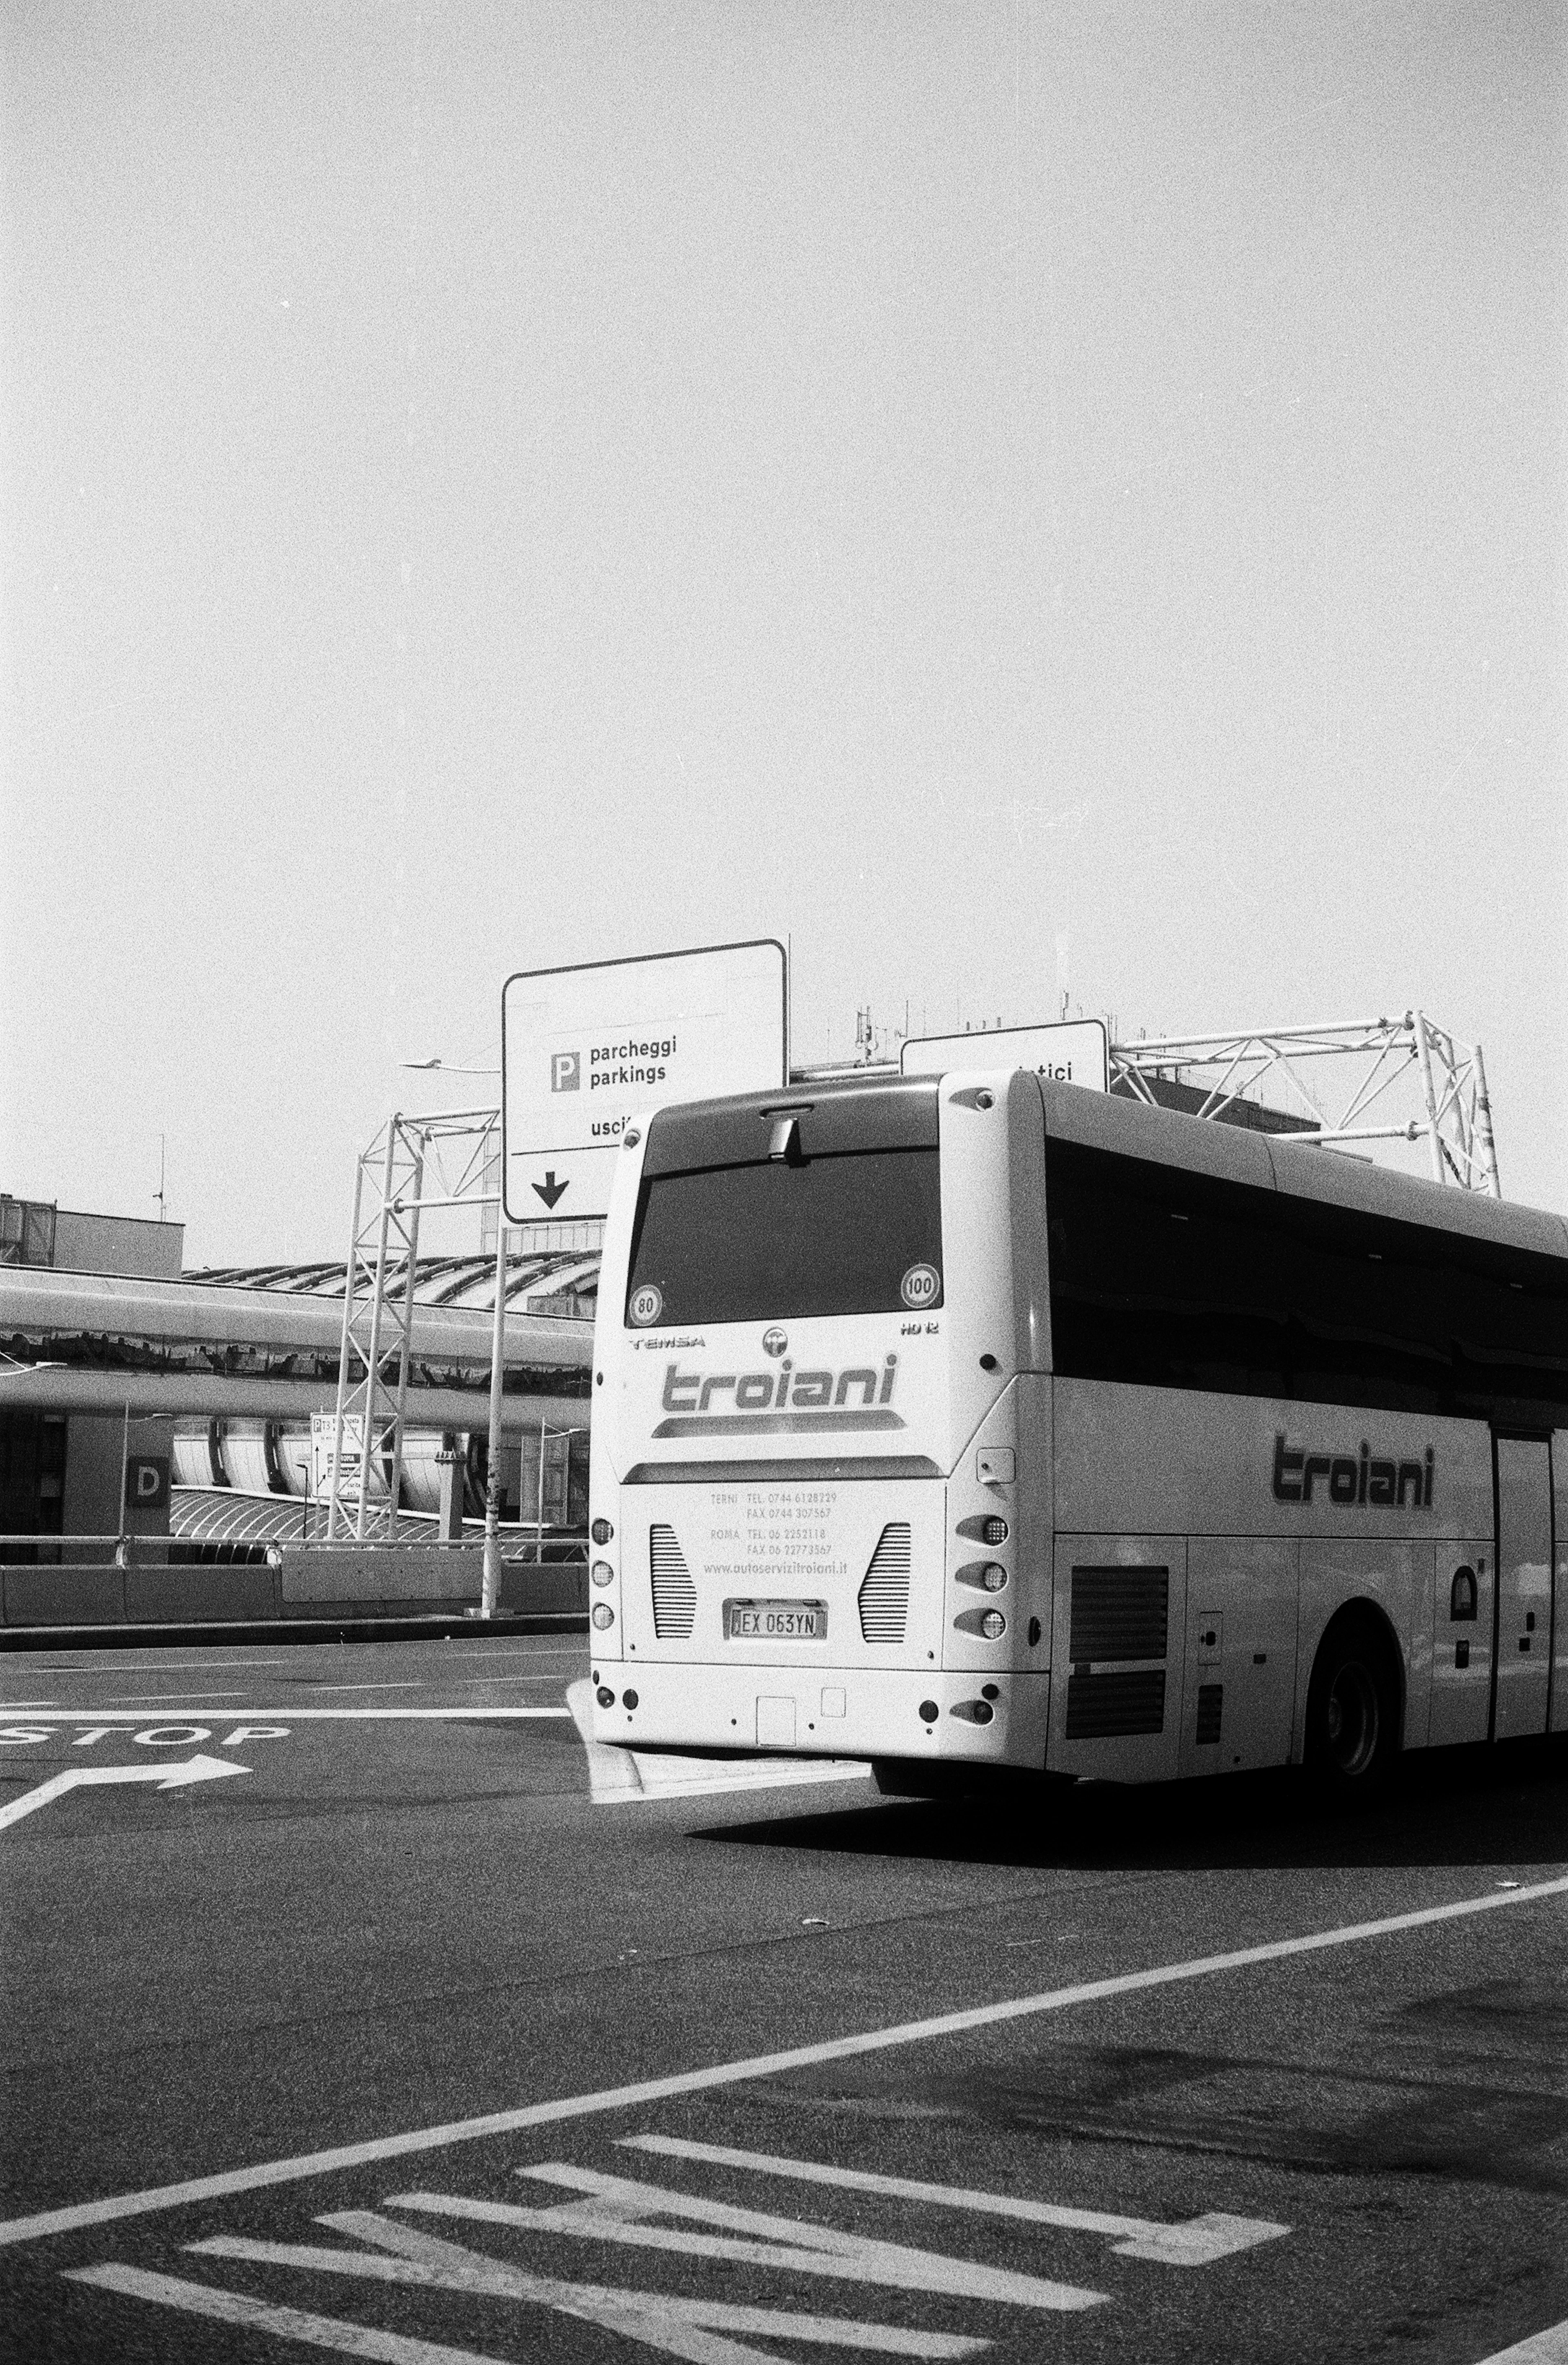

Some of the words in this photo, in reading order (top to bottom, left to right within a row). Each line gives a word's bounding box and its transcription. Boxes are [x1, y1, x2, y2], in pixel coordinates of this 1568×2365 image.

[590, 1035, 676, 1065] parcheggi
[556, 1056, 575, 1089] P
[590, 1065, 666, 1089] parkings
[591, 1116, 631, 1136] usci
[909, 1276, 931, 1295] 100
[638, 1297, 653, 1314] 80
[628, 1335, 706, 1350] TEMSA
[662, 1354, 898, 1412] troiani
[1273, 1434, 1434, 1508] troiani
[138, 1466, 160, 1496] D
[711, 1494, 737, 1504] TERNI
[747, 1493, 765, 1503] TEL.
[768, 1493, 791, 1503] 0744
[747, 1509, 765, 1519] FAX
[768, 1508, 793, 1519] 0744
[795, 1508, 831, 1519] 307567
[710, 1529, 740, 1539] ROMA
[747, 1529, 766, 1539] TEL.
[768, 1529, 780, 1539] 06
[747, 1545, 765, 1555] FAX
[768, 1545, 781, 1555] 06
[704, 1561, 847, 1574] www.autoservizitroiani.it
[742, 1613, 760, 1632] EX
[766, 1614, 814, 1633] 063YN
[0, 1726, 292, 1745] STOP
